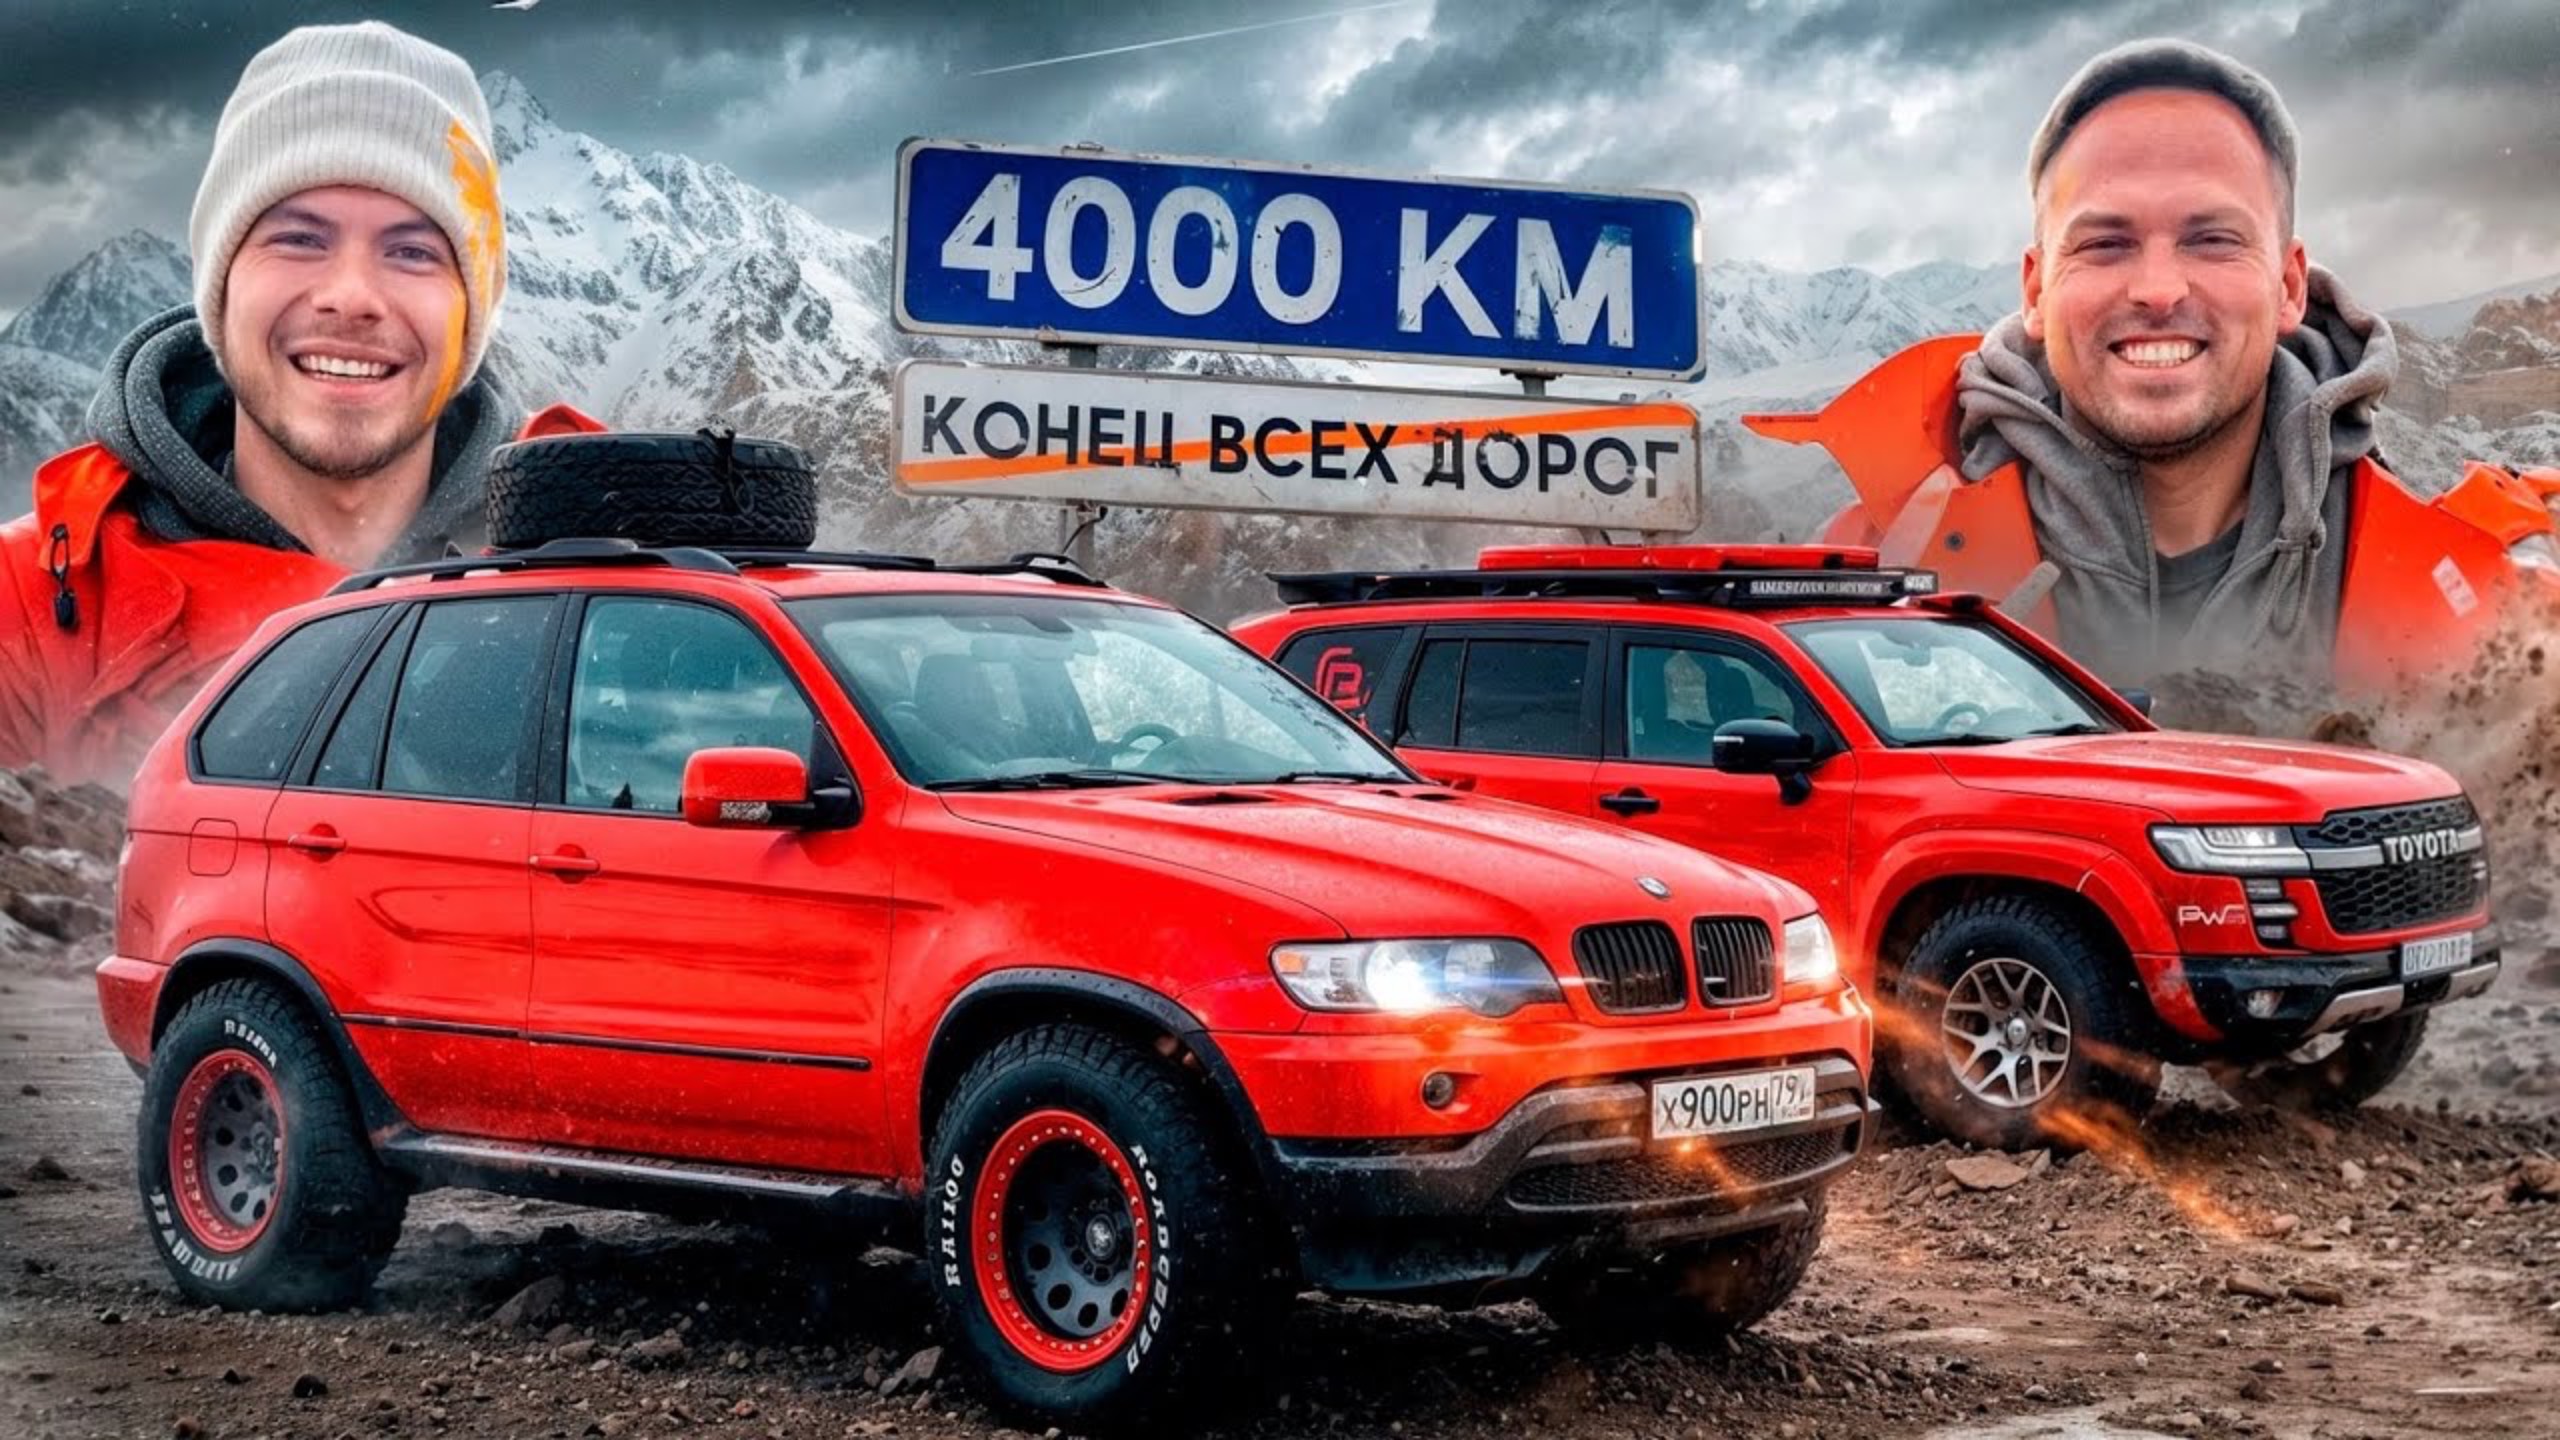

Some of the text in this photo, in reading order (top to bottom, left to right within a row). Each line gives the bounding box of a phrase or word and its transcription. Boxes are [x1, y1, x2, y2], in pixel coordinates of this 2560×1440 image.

[940, 173, 1636, 349] 4000 КМ
[921, 394, 1679, 499] КОНЕЦ ВСЕХ ДОРОГ
[2382, 828, 2458, 865] TOYOTA
